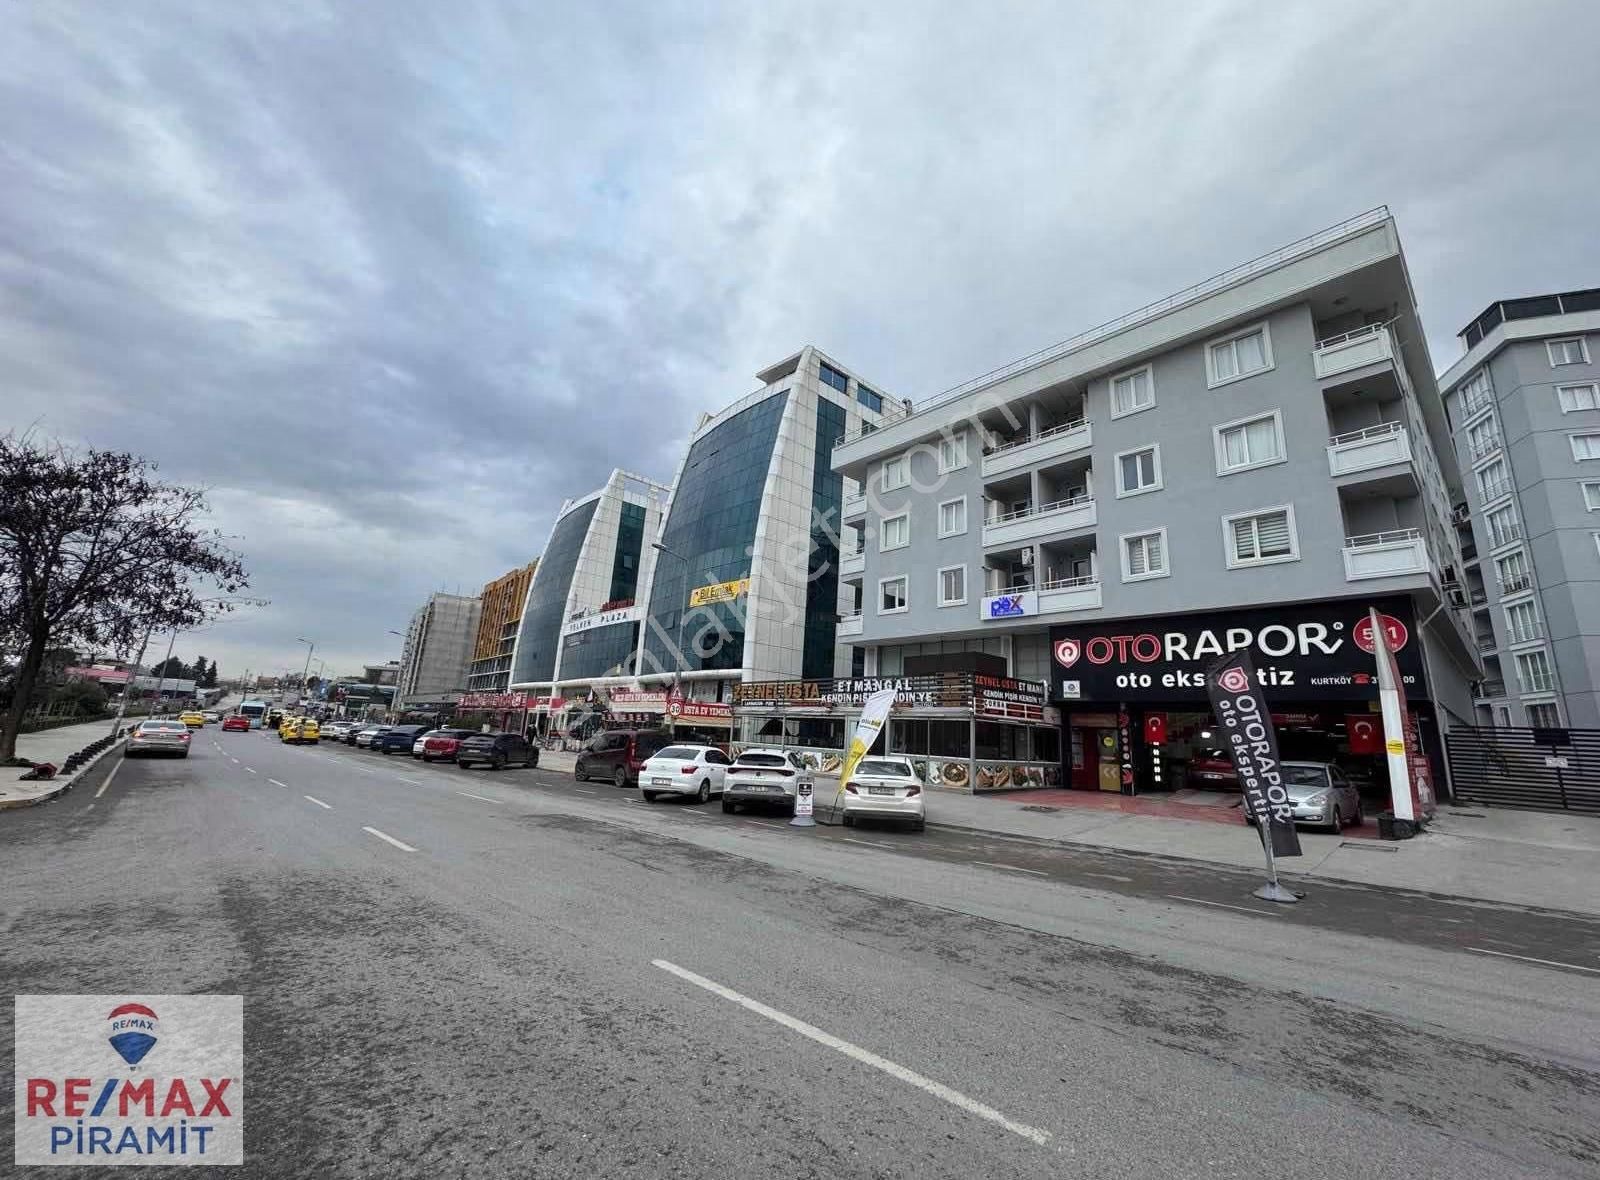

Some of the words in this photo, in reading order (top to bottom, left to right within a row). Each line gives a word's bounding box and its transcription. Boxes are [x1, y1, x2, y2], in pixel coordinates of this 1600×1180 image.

[601, 611, 627, 624] PLAZA
[1362, 626, 1397, 641] 51
[1086, 621, 1344, 664] OTORAPOR
[837, 680, 852, 692] ET
[854, 678, 912, 692] MANGAL
[975, 675, 1001, 688] ZEYNEL
[1001, 678, 1018, 691] USTA
[1018, 681, 1026, 691] ET
[1116, 672, 1152, 688] oto
[1162, 666, 1296, 687] ekstiz
[1310, 674, 1352, 685] KURTKÖY
[784, 682, 820, 699] USTA
[671, 704, 680, 713] 30
[1219, 700, 1237, 727] oto
[1236, 694, 1292, 824] OTORAPOR
